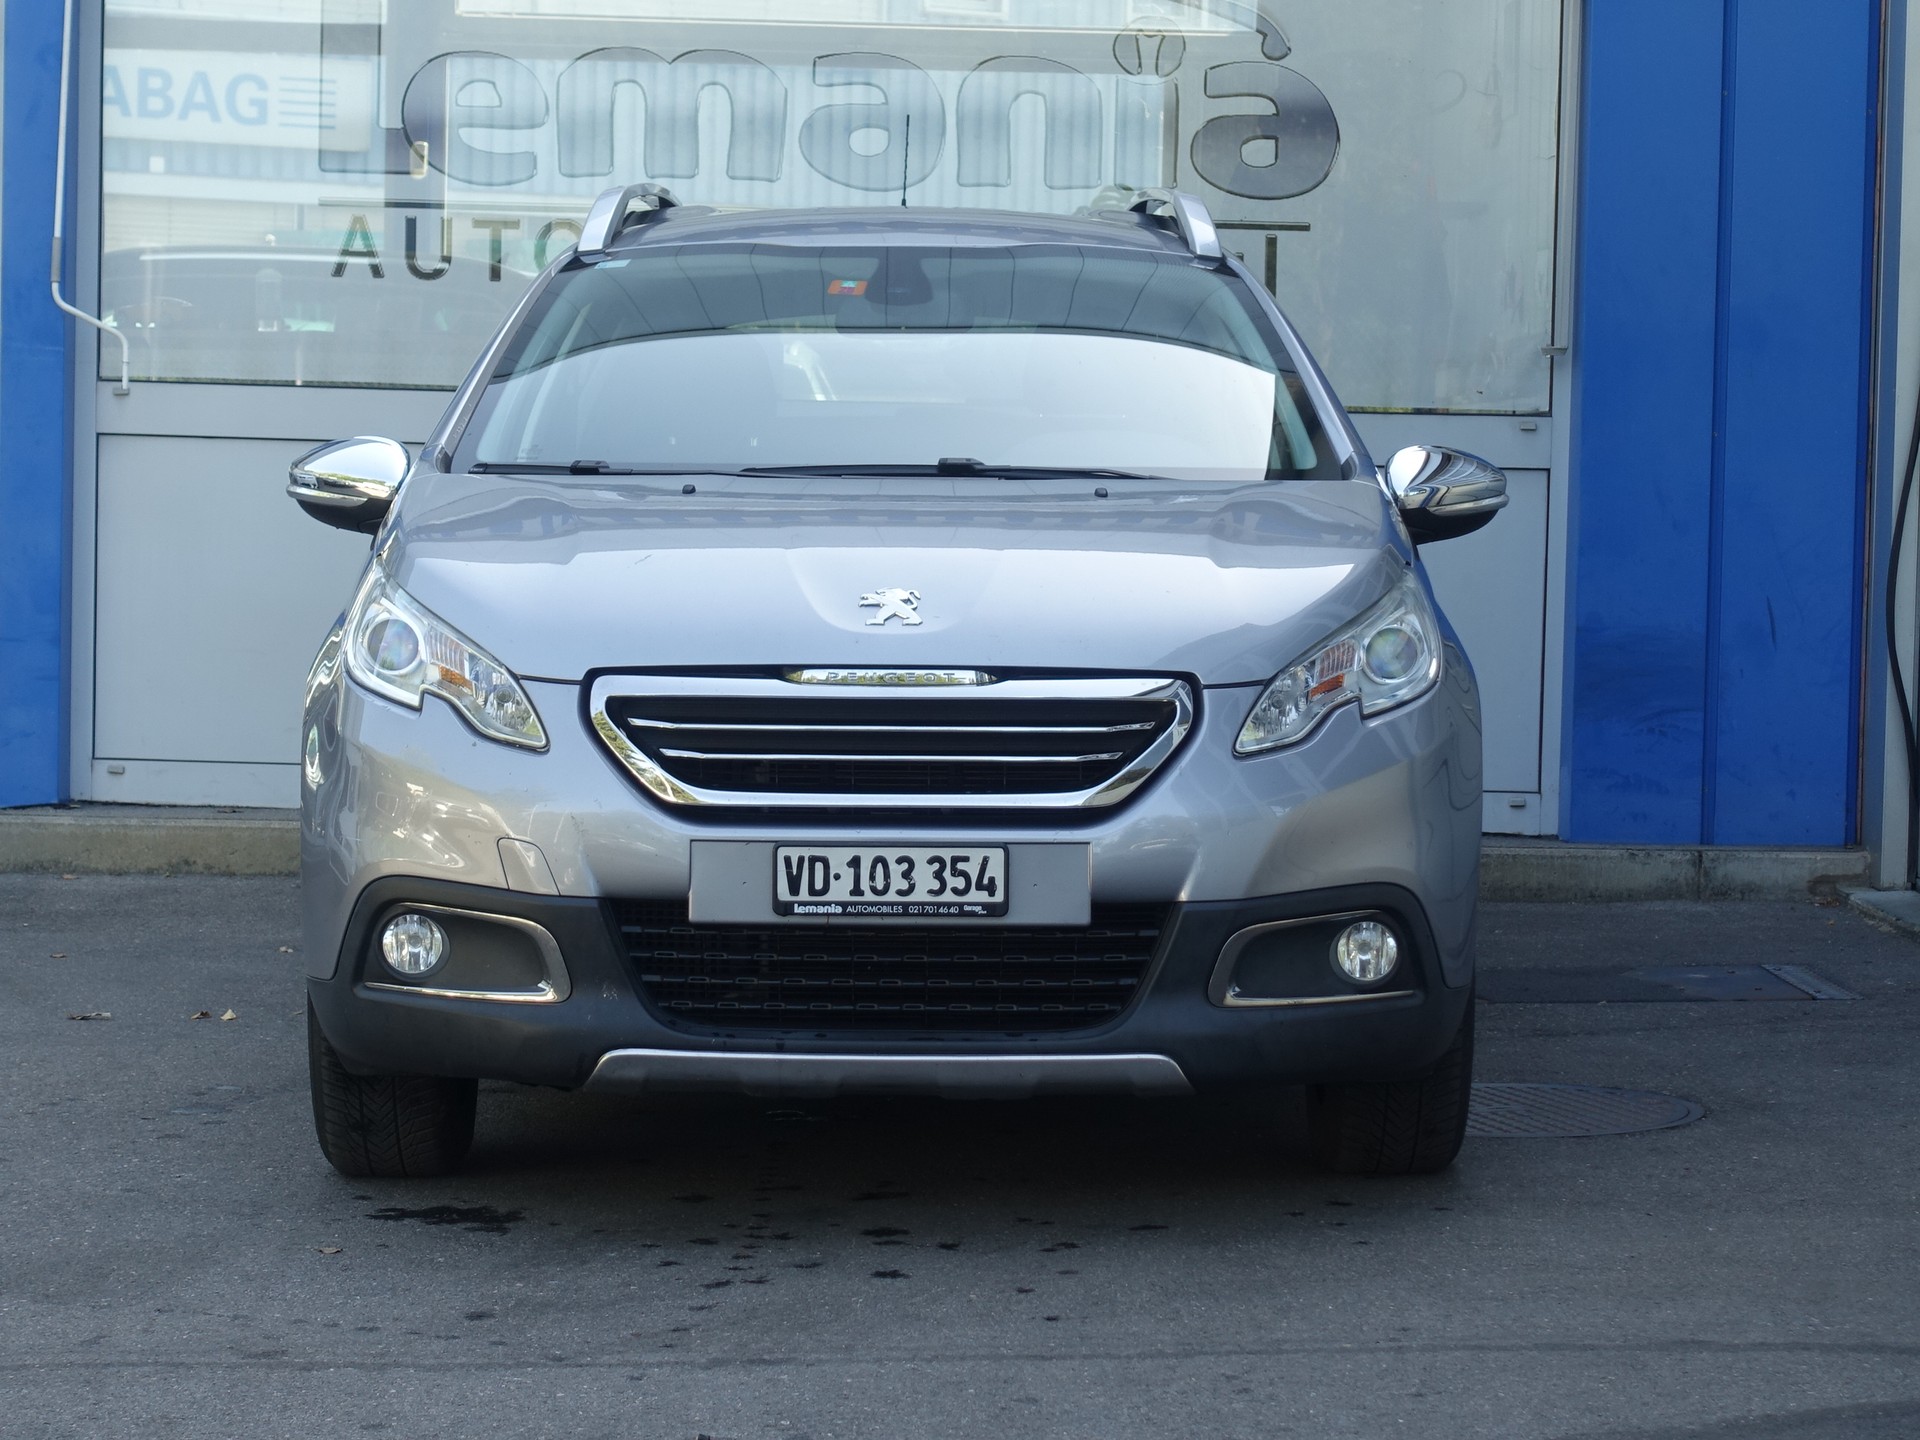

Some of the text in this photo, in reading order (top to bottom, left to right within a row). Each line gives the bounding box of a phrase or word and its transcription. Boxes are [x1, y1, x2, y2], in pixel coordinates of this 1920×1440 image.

[318, 0, 1341, 200] Lemania
[827, 671, 956, 684] PEUGEOT
[793, 903, 843, 914] Lemania
[846, 905, 904, 914] AUTOMOBILES
